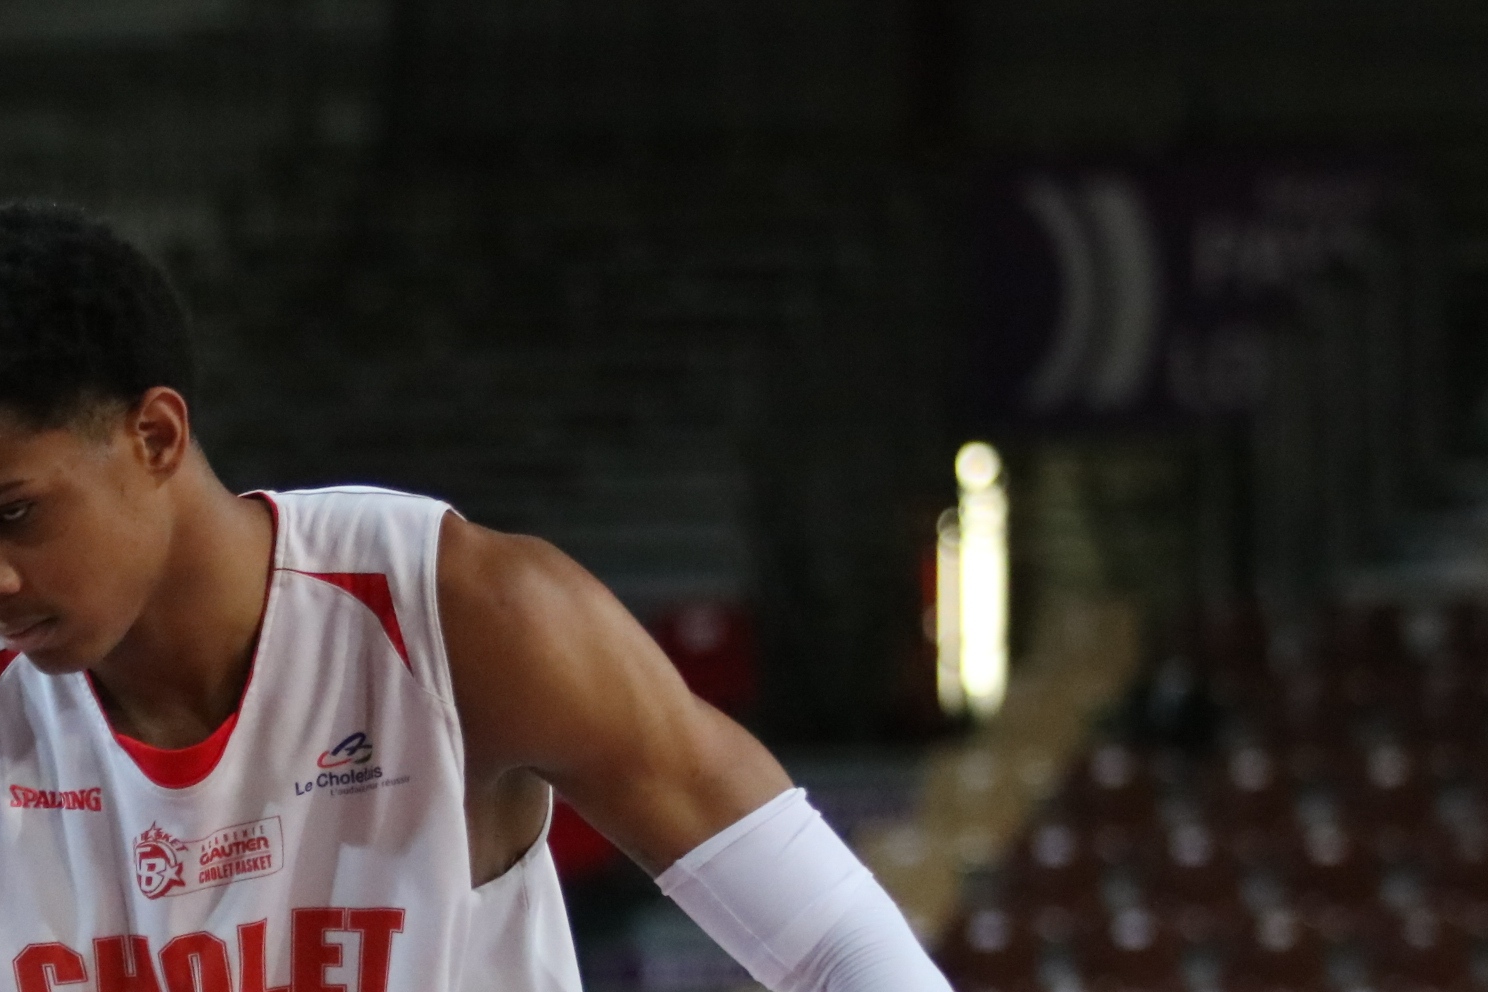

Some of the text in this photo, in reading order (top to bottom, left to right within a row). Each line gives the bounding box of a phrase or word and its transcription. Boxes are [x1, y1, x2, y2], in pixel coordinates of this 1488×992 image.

[9, 784, 102, 812] SPALDING
[295, 781, 313, 796] Le
[199, 836, 270, 866] GAUTIER
[198, 854, 273, 884] CHOLET BASKET
